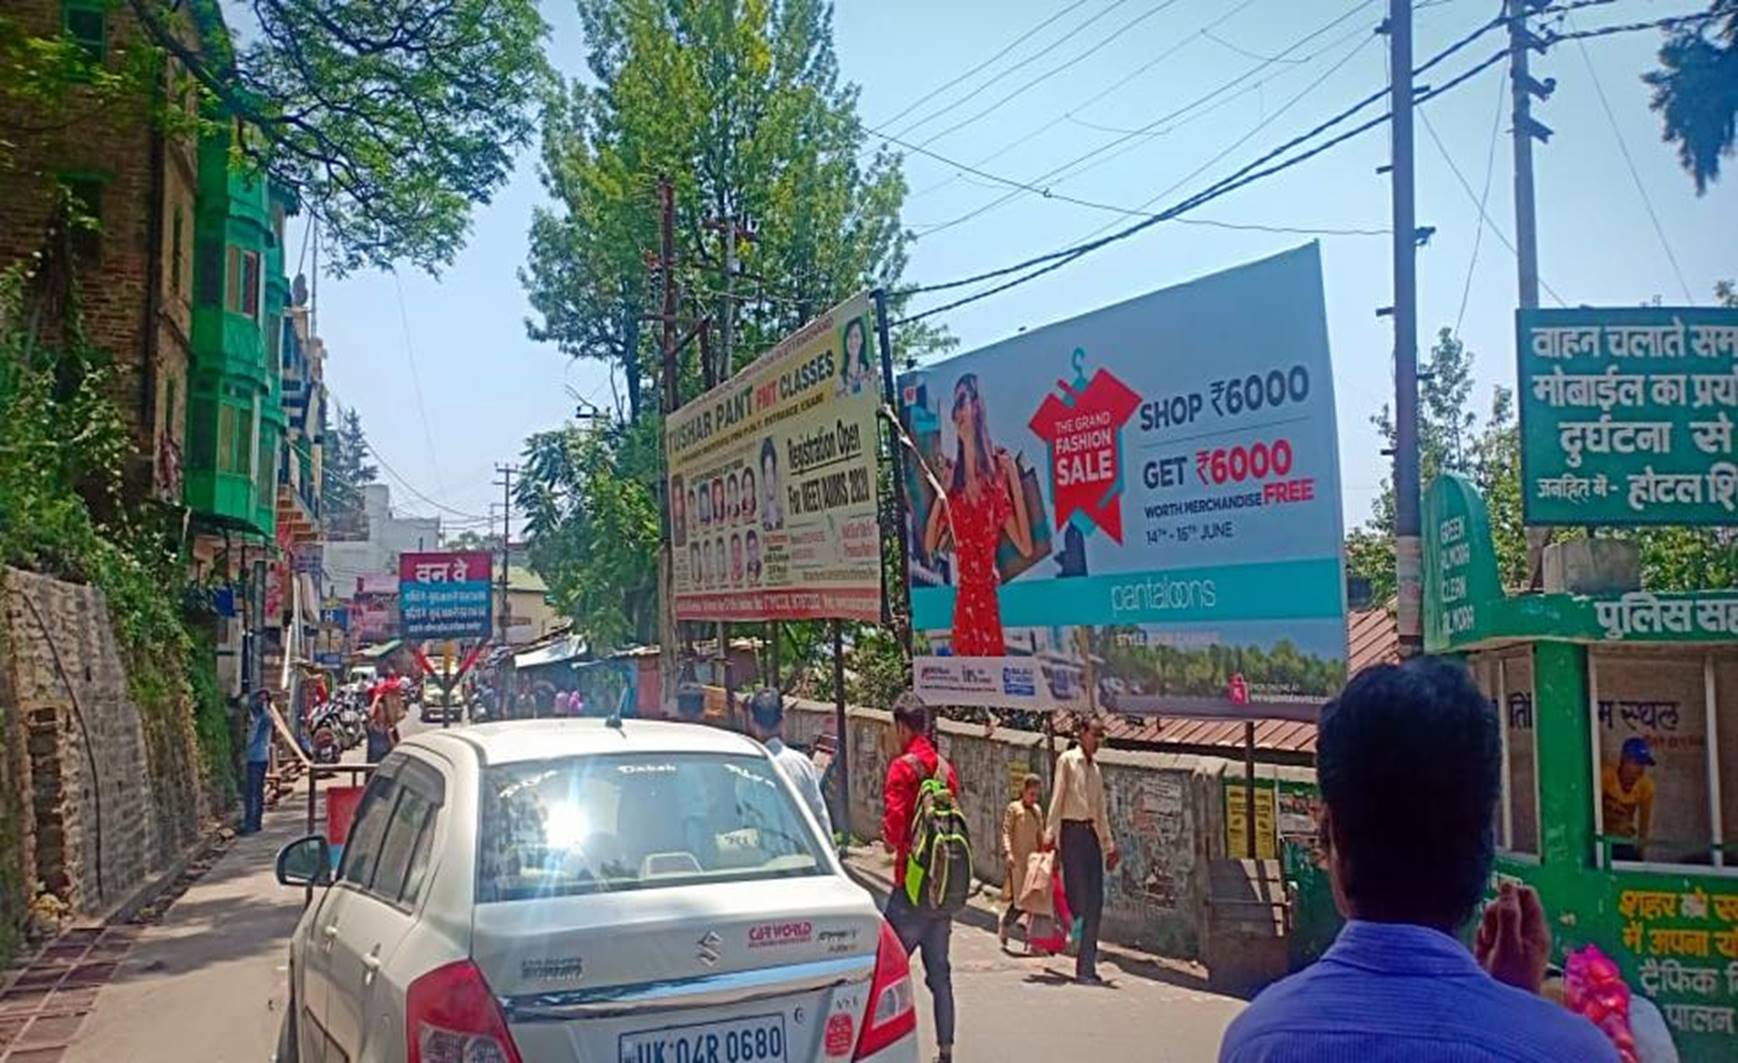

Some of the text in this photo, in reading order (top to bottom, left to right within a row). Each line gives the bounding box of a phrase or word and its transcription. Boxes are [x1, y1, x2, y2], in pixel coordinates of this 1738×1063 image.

[1531, 325, 1600, 359] वाहन
[1605, 316, 1685, 358] चलाते
[716, 386, 754, 431] PANT
[779, 350, 835, 400] CLASSES
[1140, 365, 1309, 431] SHOP ₹6000
[1532, 365, 1645, 411] मोबाईल
[1650, 374, 1687, 406] का
[837, 420, 861, 461] Open
[1056, 412, 1111, 433] THE GRAND
[1056, 428, 1112, 454] FASHION
[1558, 412, 1734, 468] दुर्घटना से
[1056, 450, 1114, 485] SALE
[1144, 439, 1292, 489] GET ₹6000
[1145, 479, 1314, 519] WORTH MERCHANDISE FREE
[1537, 473, 1590, 503] जनहित
[1626, 466, 1701, 510] होटल
[1200, 523, 1233, 540] JUNE
[416, 558, 469, 584] वन वे
[1111, 575, 1216, 617] pantaloons
[1594, 591, 1693, 640] पुलिस
[1619, 700, 1680, 731] स्थल
[773, 922, 812, 938] WORLD
[1664, 1003, 1735, 1034] पालन
[726, 1026, 782, 1063] 0680
